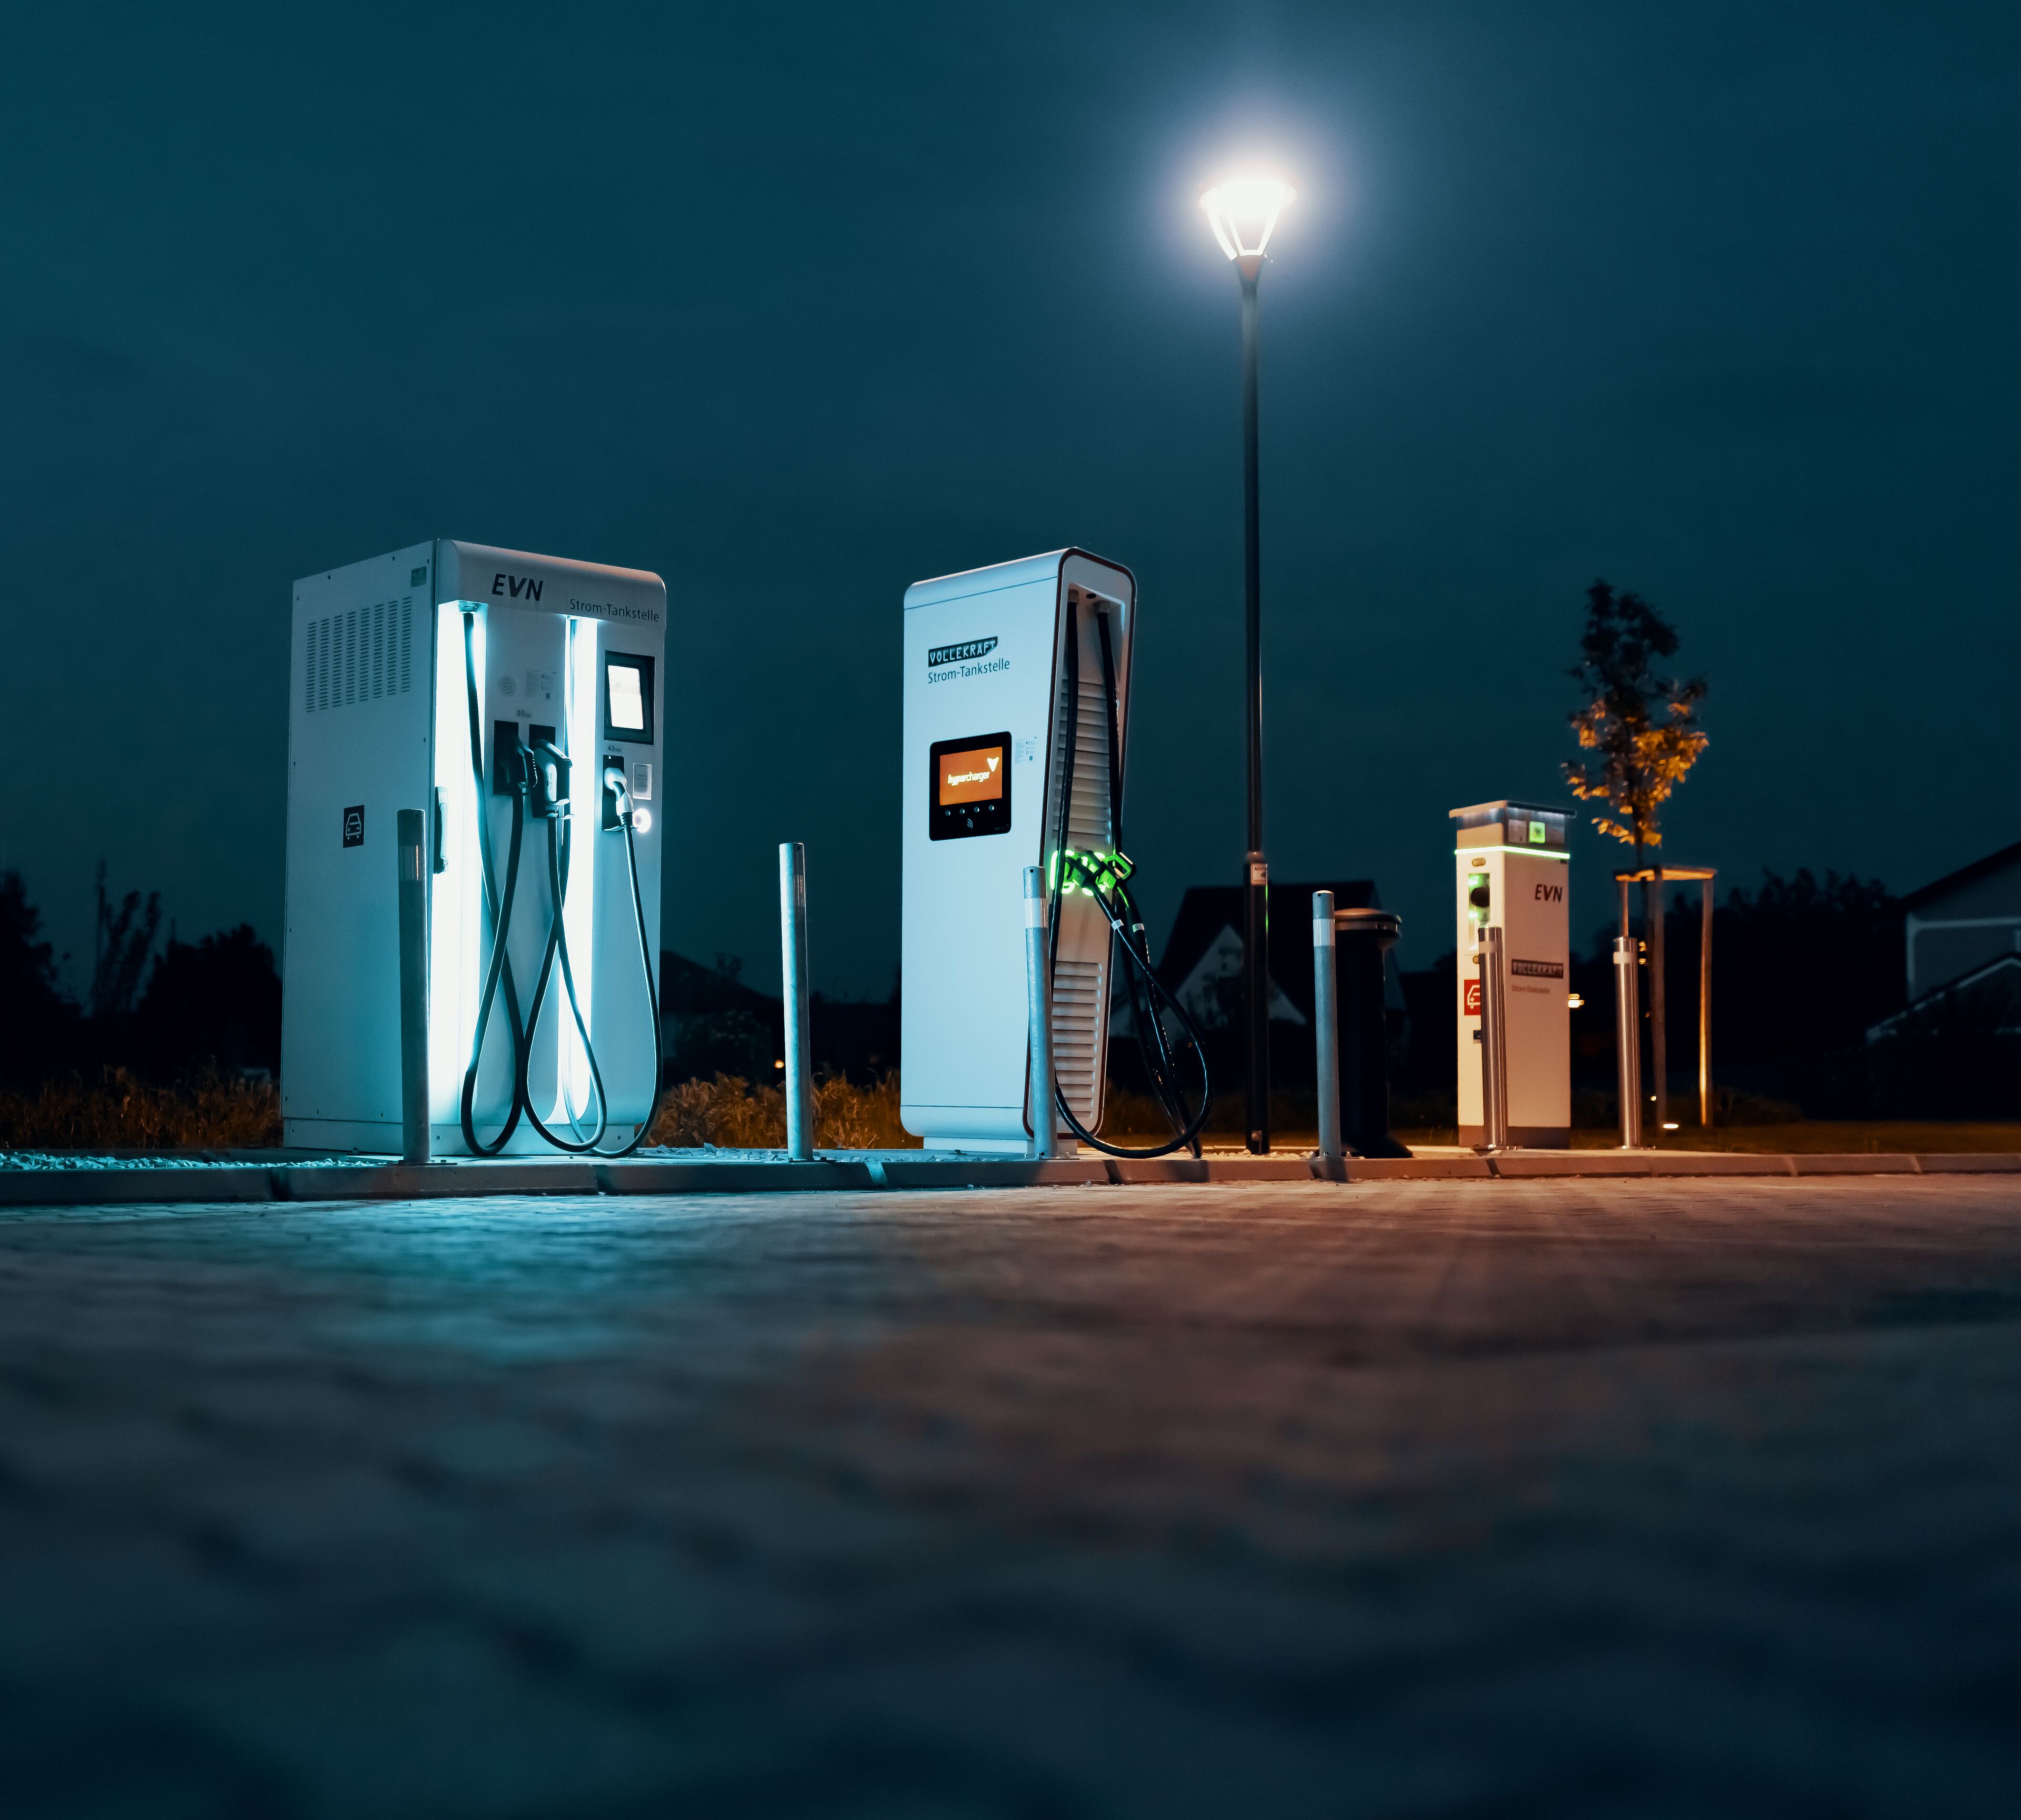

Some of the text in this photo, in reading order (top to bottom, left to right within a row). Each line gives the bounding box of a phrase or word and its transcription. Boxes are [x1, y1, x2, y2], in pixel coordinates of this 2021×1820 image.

[492, 574, 543, 601] EVN
[570, 599, 659, 622] Strom-Tankstelle
[929, 640, 996, 664] VOLLEKRAFT
[928, 658, 1010, 683] Strom-Tankstelle
[948, 771, 990, 786] hypercharger
[1535, 884, 1563, 903] EVN
